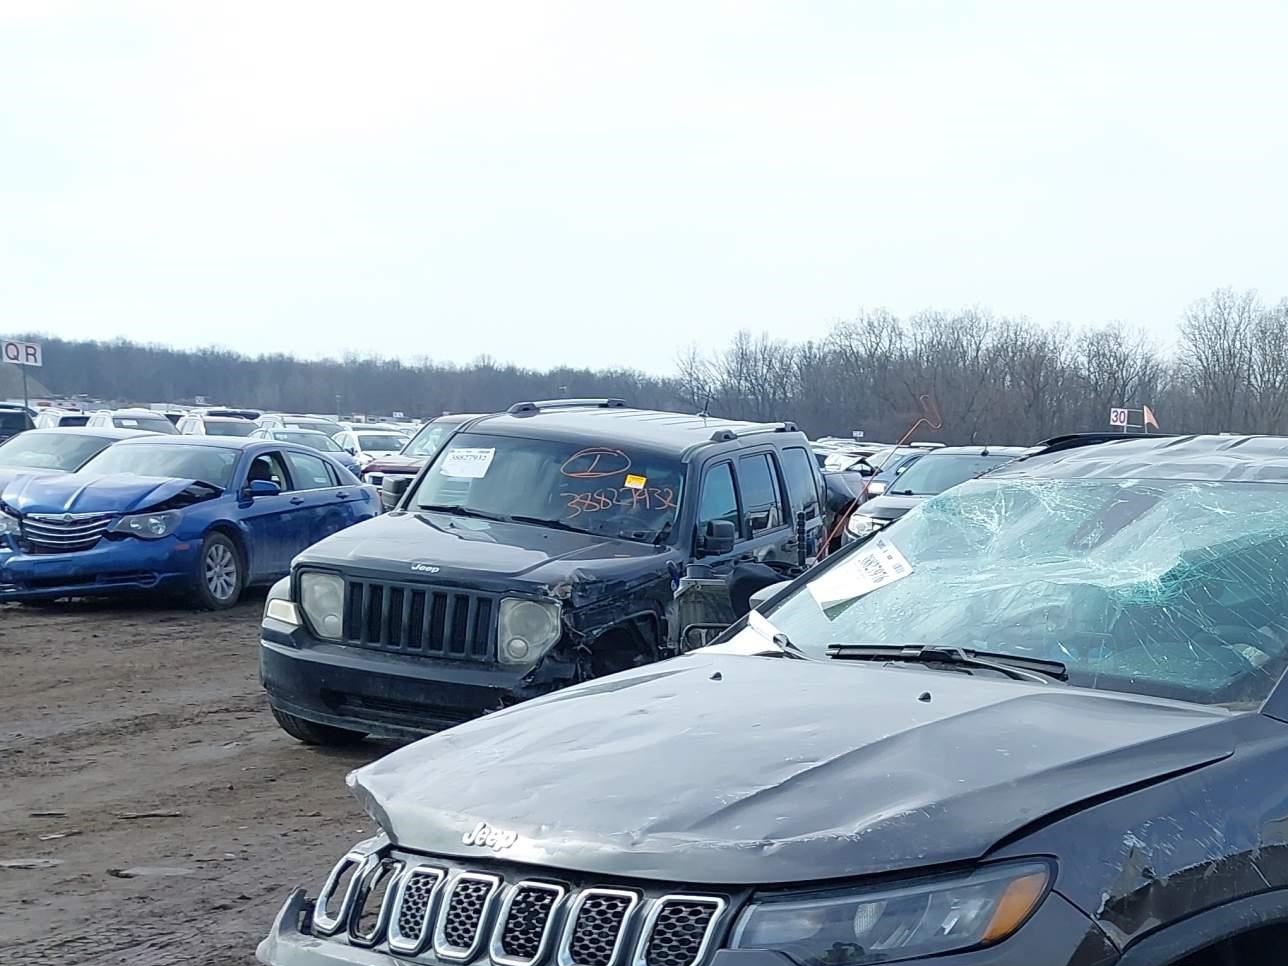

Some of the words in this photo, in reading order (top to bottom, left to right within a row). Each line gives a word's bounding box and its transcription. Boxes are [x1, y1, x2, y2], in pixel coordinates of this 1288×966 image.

[1111, 410, 1126, 424] 30
[411, 563, 440, 573] Jeep
[462, 821, 518, 852] Jeep
